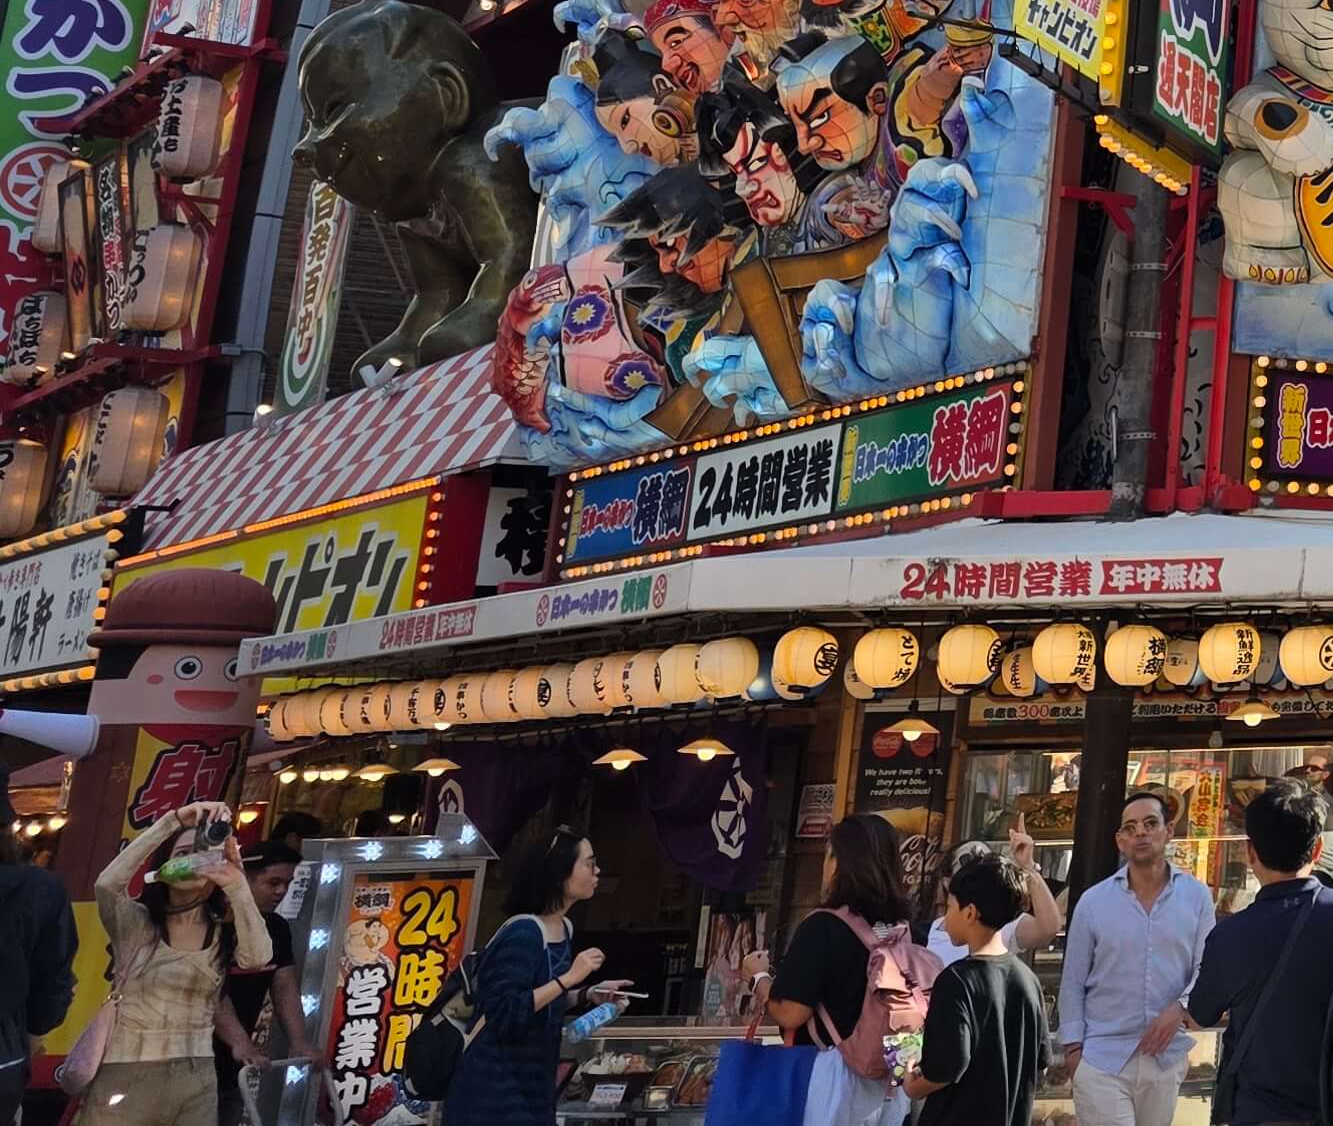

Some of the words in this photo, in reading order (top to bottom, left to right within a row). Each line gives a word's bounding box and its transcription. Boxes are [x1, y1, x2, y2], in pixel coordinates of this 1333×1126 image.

[1156, 31, 1223, 146] 通天閣店
[853, 433, 929, 482] 日本一の串かつ
[928, 393, 1006, 487] 横綱
[579, 494, 634, 540] 日本一の串かつ
[632, 468, 690, 545] 横綱
[693, 439, 834, 530] 24時間営業
[550, 588, 618, 623] 日本一の串かつ
[620, 577, 653, 615] 横綱
[900, 560, 1092, 601] 24時間営業
[1108, 559, 1217, 592] 年中無休
[379, 612, 436, 650] 24時間営業
[1071, 638, 1093, 678] 新世界
[334, 966, 390, 1121] 営業中
